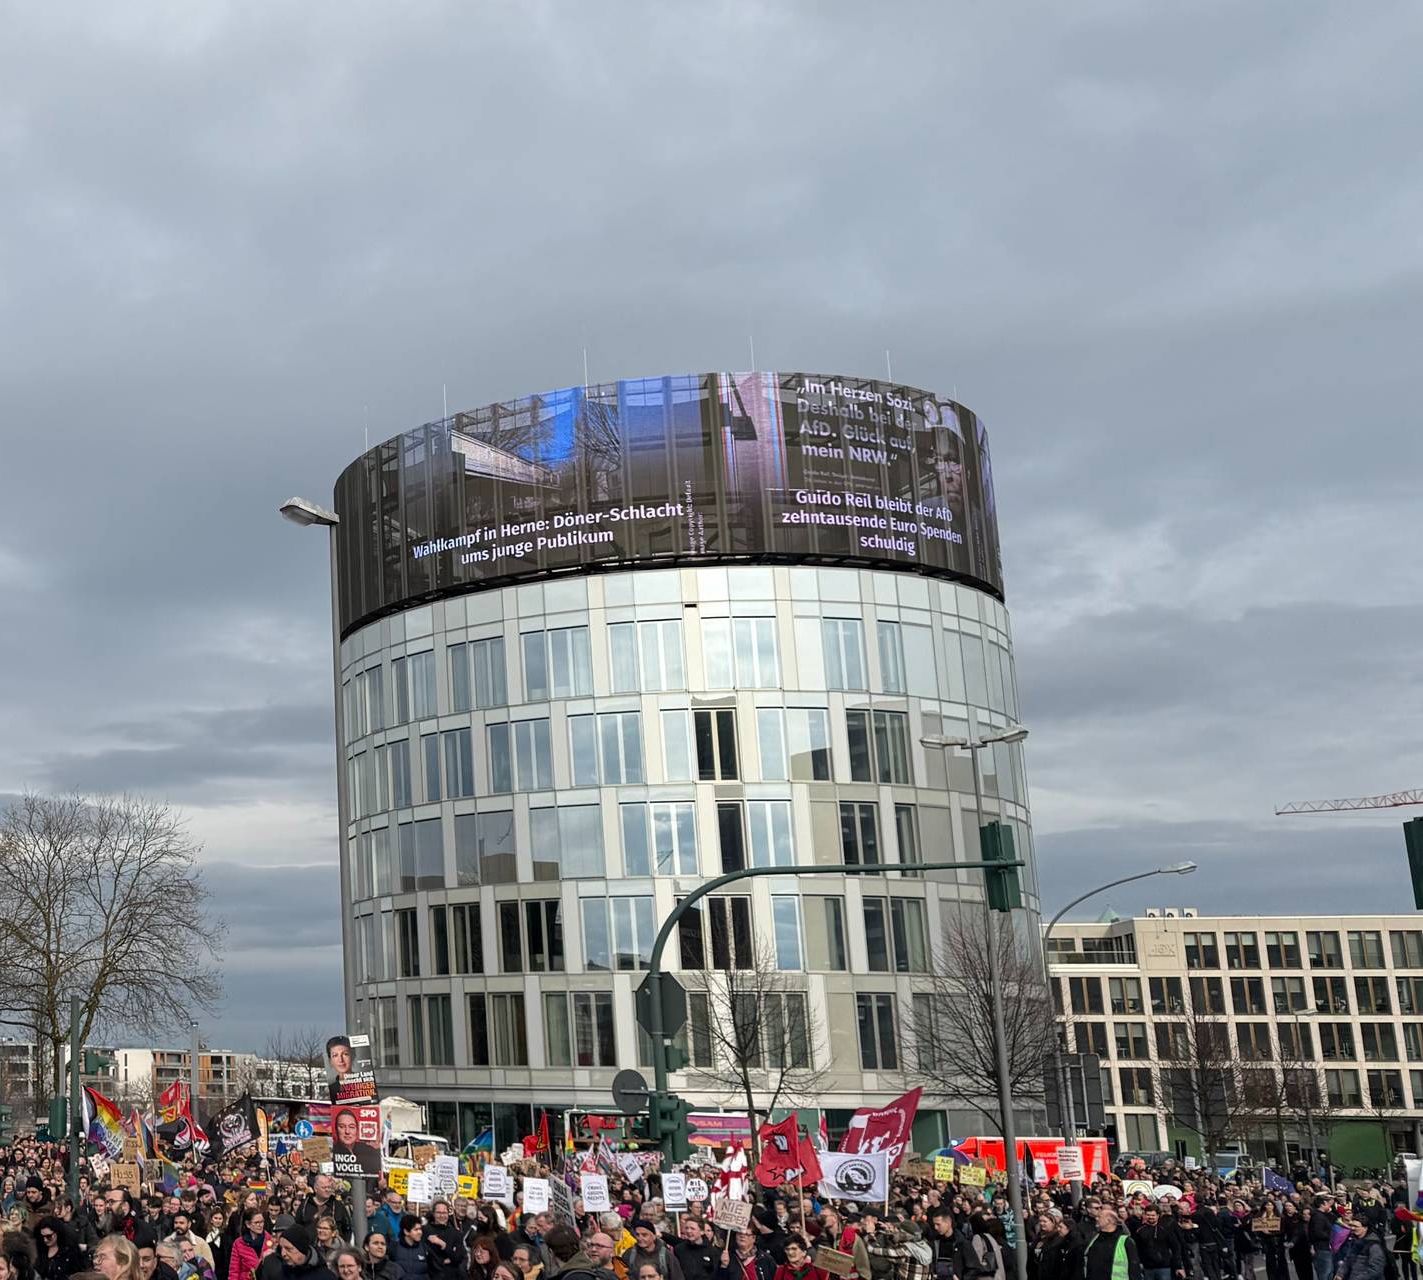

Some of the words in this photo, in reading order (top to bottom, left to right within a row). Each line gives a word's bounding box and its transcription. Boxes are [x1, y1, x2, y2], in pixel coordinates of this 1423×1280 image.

[830, 381, 882, 402] Herzen
[886, 392, 916, 412] Sozi.
[797, 398, 865, 420] Deshalb
[869, 407, 891, 425] bei
[800, 419, 837, 437] AfD.
[843, 424, 886, 445] Glück
[802, 442, 843, 459] mein
[795, 489, 842, 506] Guido
[845, 493, 872, 509] Reil
[875, 495, 913, 514] bleibt
[915, 503, 933, 517] der
[935, 508, 953, 523] AfD
[413, 527, 480, 559] Wahlkampf
[483, 526, 497, 542] in
[500, 519, 550, 538] Herne:
[553, 502, 684, 530] Döner-Schlacht
[781, 510, 887, 529] zehntausende
[890, 519, 918, 534] Euro
[920, 523, 963, 545] Spenden
[461, 548, 489, 564] ums
[491, 541, 533, 562] junge
[537, 529, 614, 551] Publikum
[860, 534, 916, 556] schuldig
[360, 1109, 377, 1118] SPD
[335, 1153, 357, 1163] INGO
[336, 1163, 364, 1173] VOGEL
[714, 1211, 748, 1226] WIEDER
[721, 1202, 742, 1214] NIE
